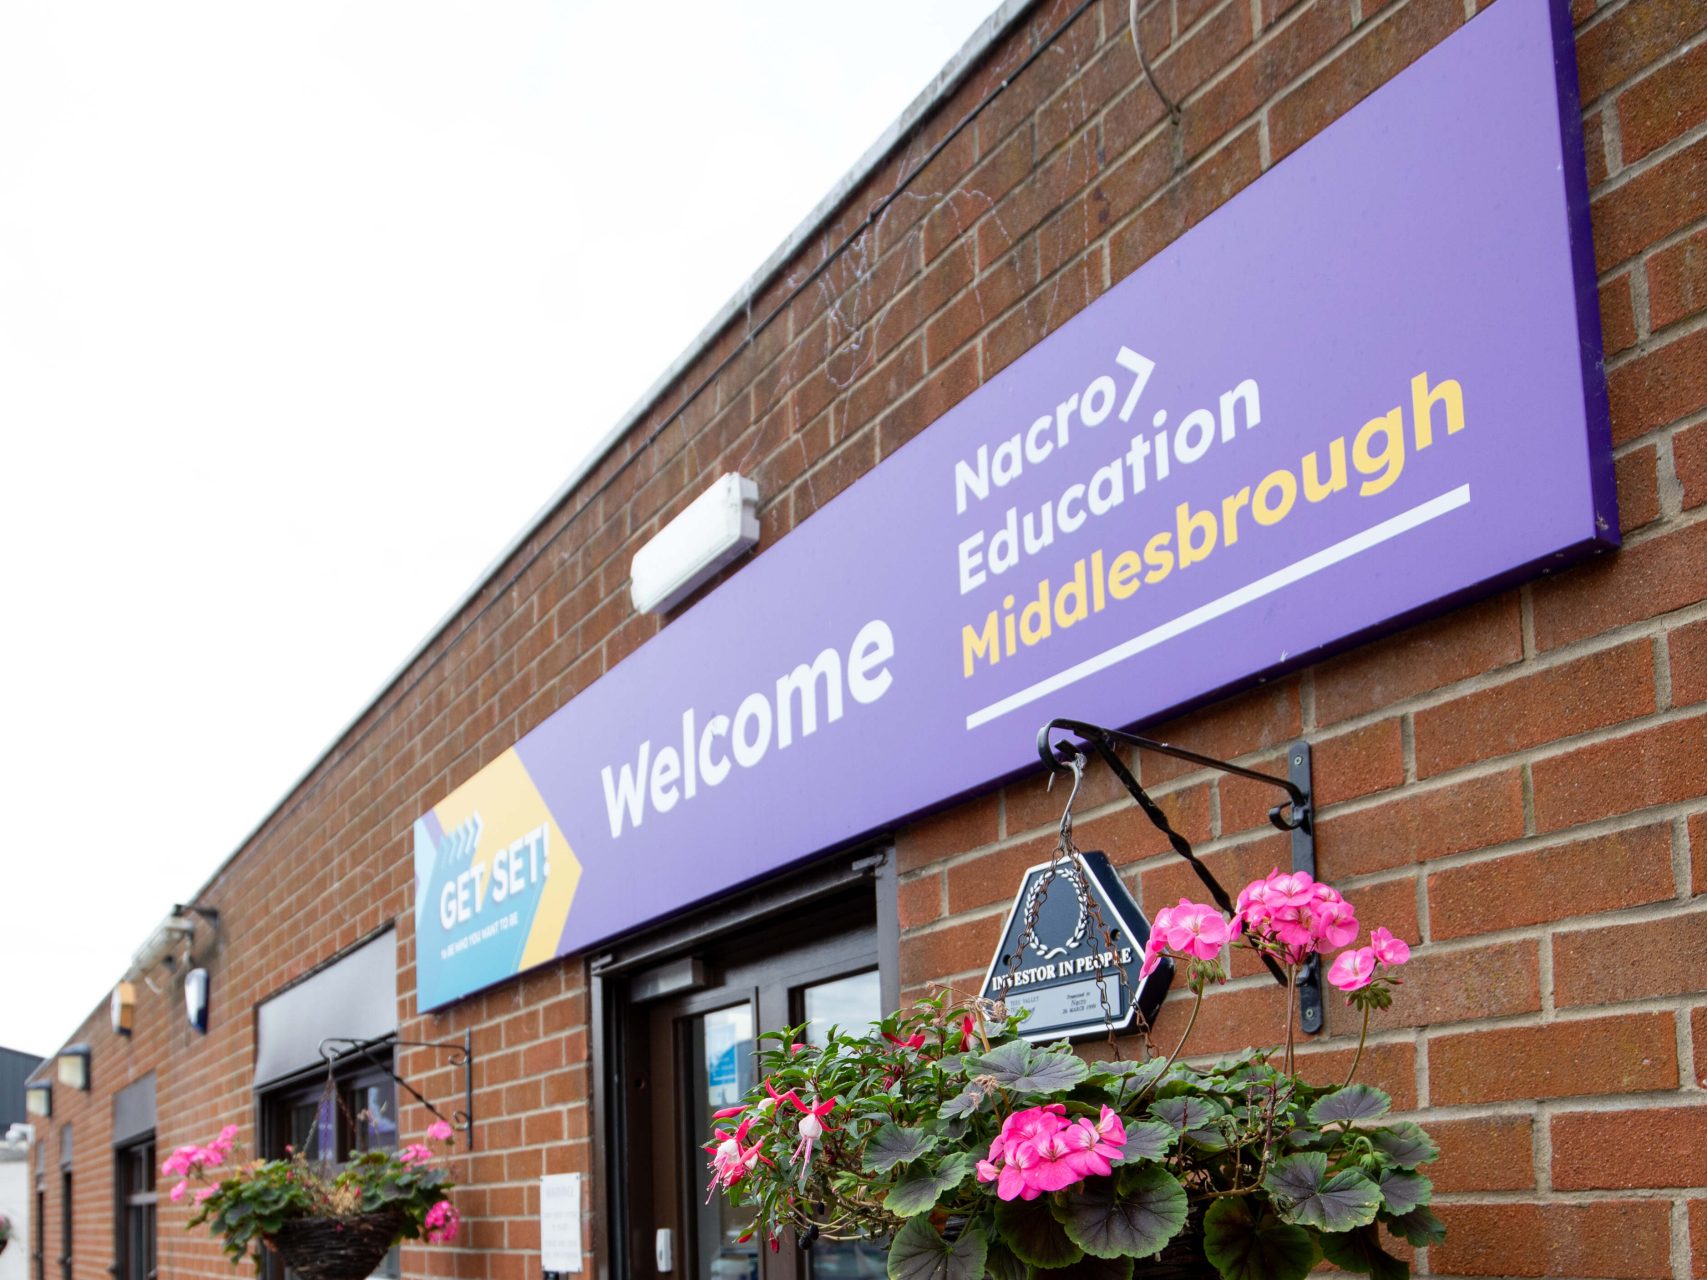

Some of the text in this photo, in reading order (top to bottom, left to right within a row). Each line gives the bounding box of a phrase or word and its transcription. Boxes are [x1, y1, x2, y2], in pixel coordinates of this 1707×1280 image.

[955, 375, 1117, 515] Nacro
[958, 377, 1262, 595] Education
[961, 371, 1466, 679] Middlesbrough
[600, 619, 895, 839] Welcome
[440, 822, 550, 931] GET SET!
[1059, 959, 1074, 977] IN
[1076, 947, 1132, 973] PEOPE
